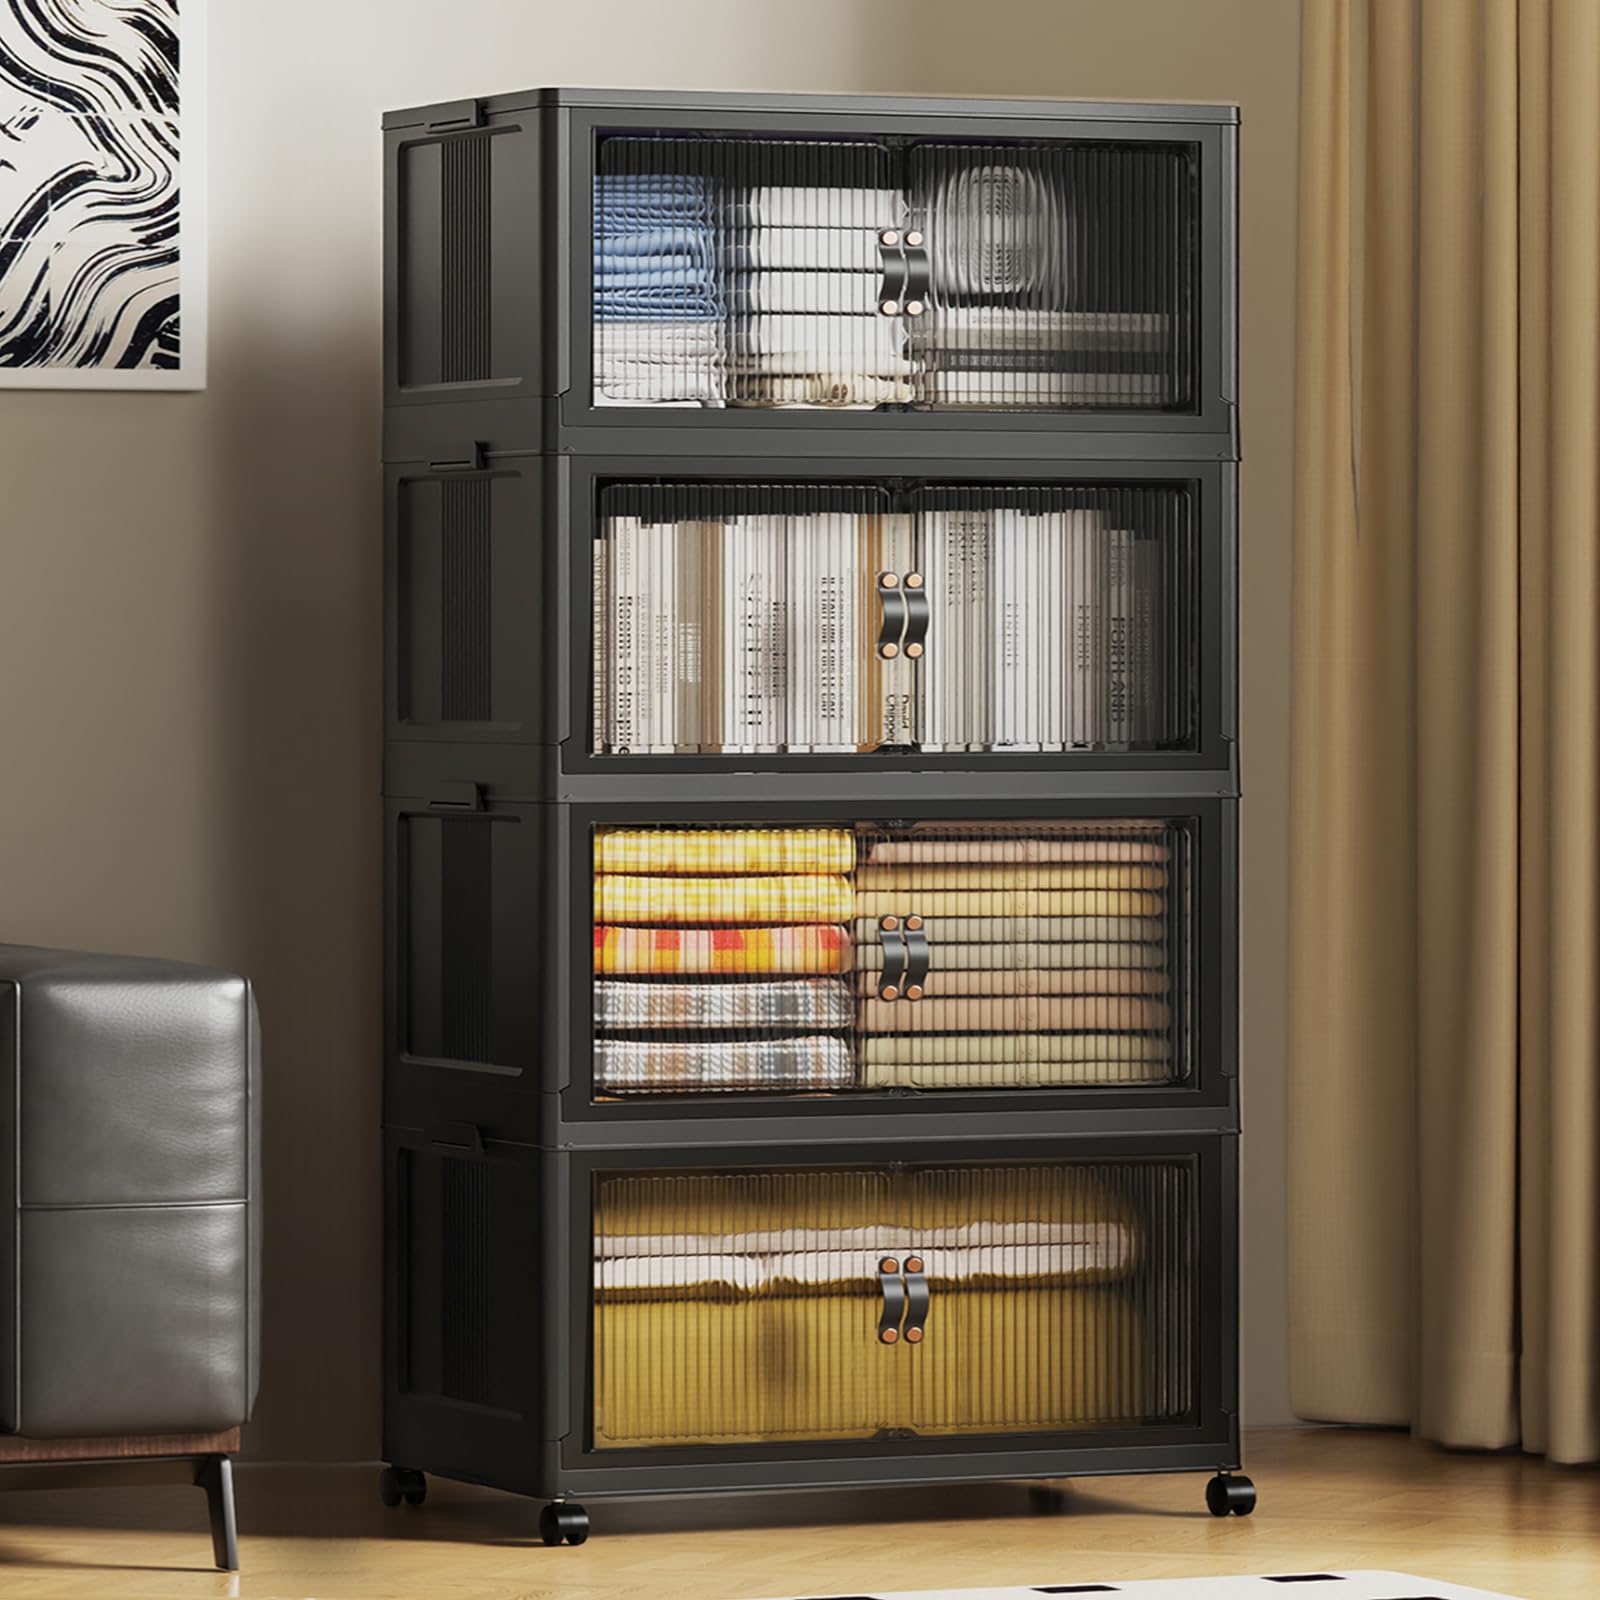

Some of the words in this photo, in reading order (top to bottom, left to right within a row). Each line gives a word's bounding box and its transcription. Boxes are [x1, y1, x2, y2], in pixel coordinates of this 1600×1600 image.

[619, 596, 633, 659] Rooms
[619, 667, 633, 685] to
[1110, 617, 1126, 722] PORTLAND
